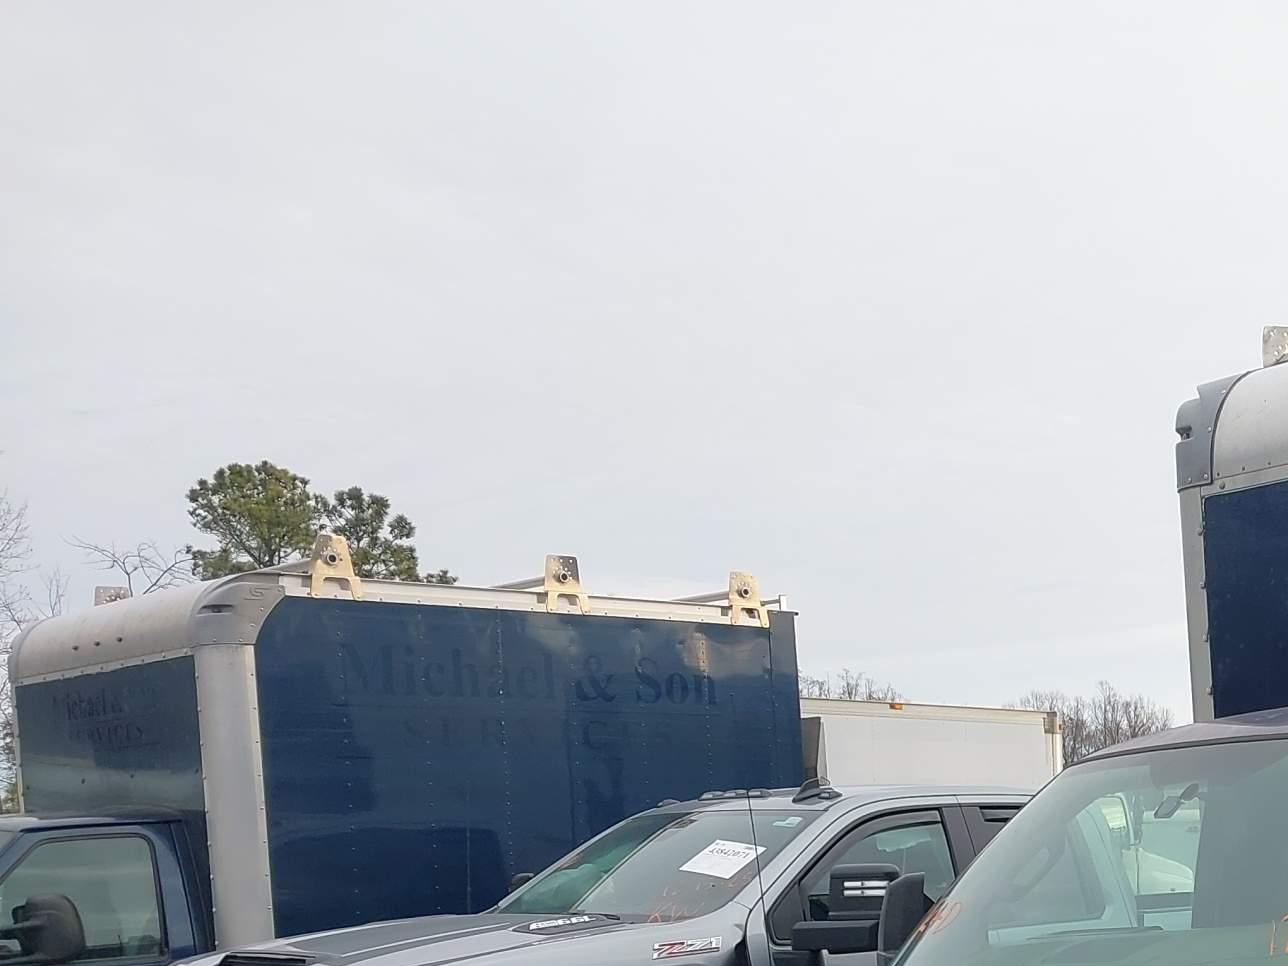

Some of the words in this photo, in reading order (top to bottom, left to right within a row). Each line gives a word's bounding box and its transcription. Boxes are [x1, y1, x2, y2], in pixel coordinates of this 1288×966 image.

[340, 642, 556, 700] Michael
[575, 654, 616, 704] &
[635, 656, 718, 706] Son
[651, 935, 723, 961] Z71
